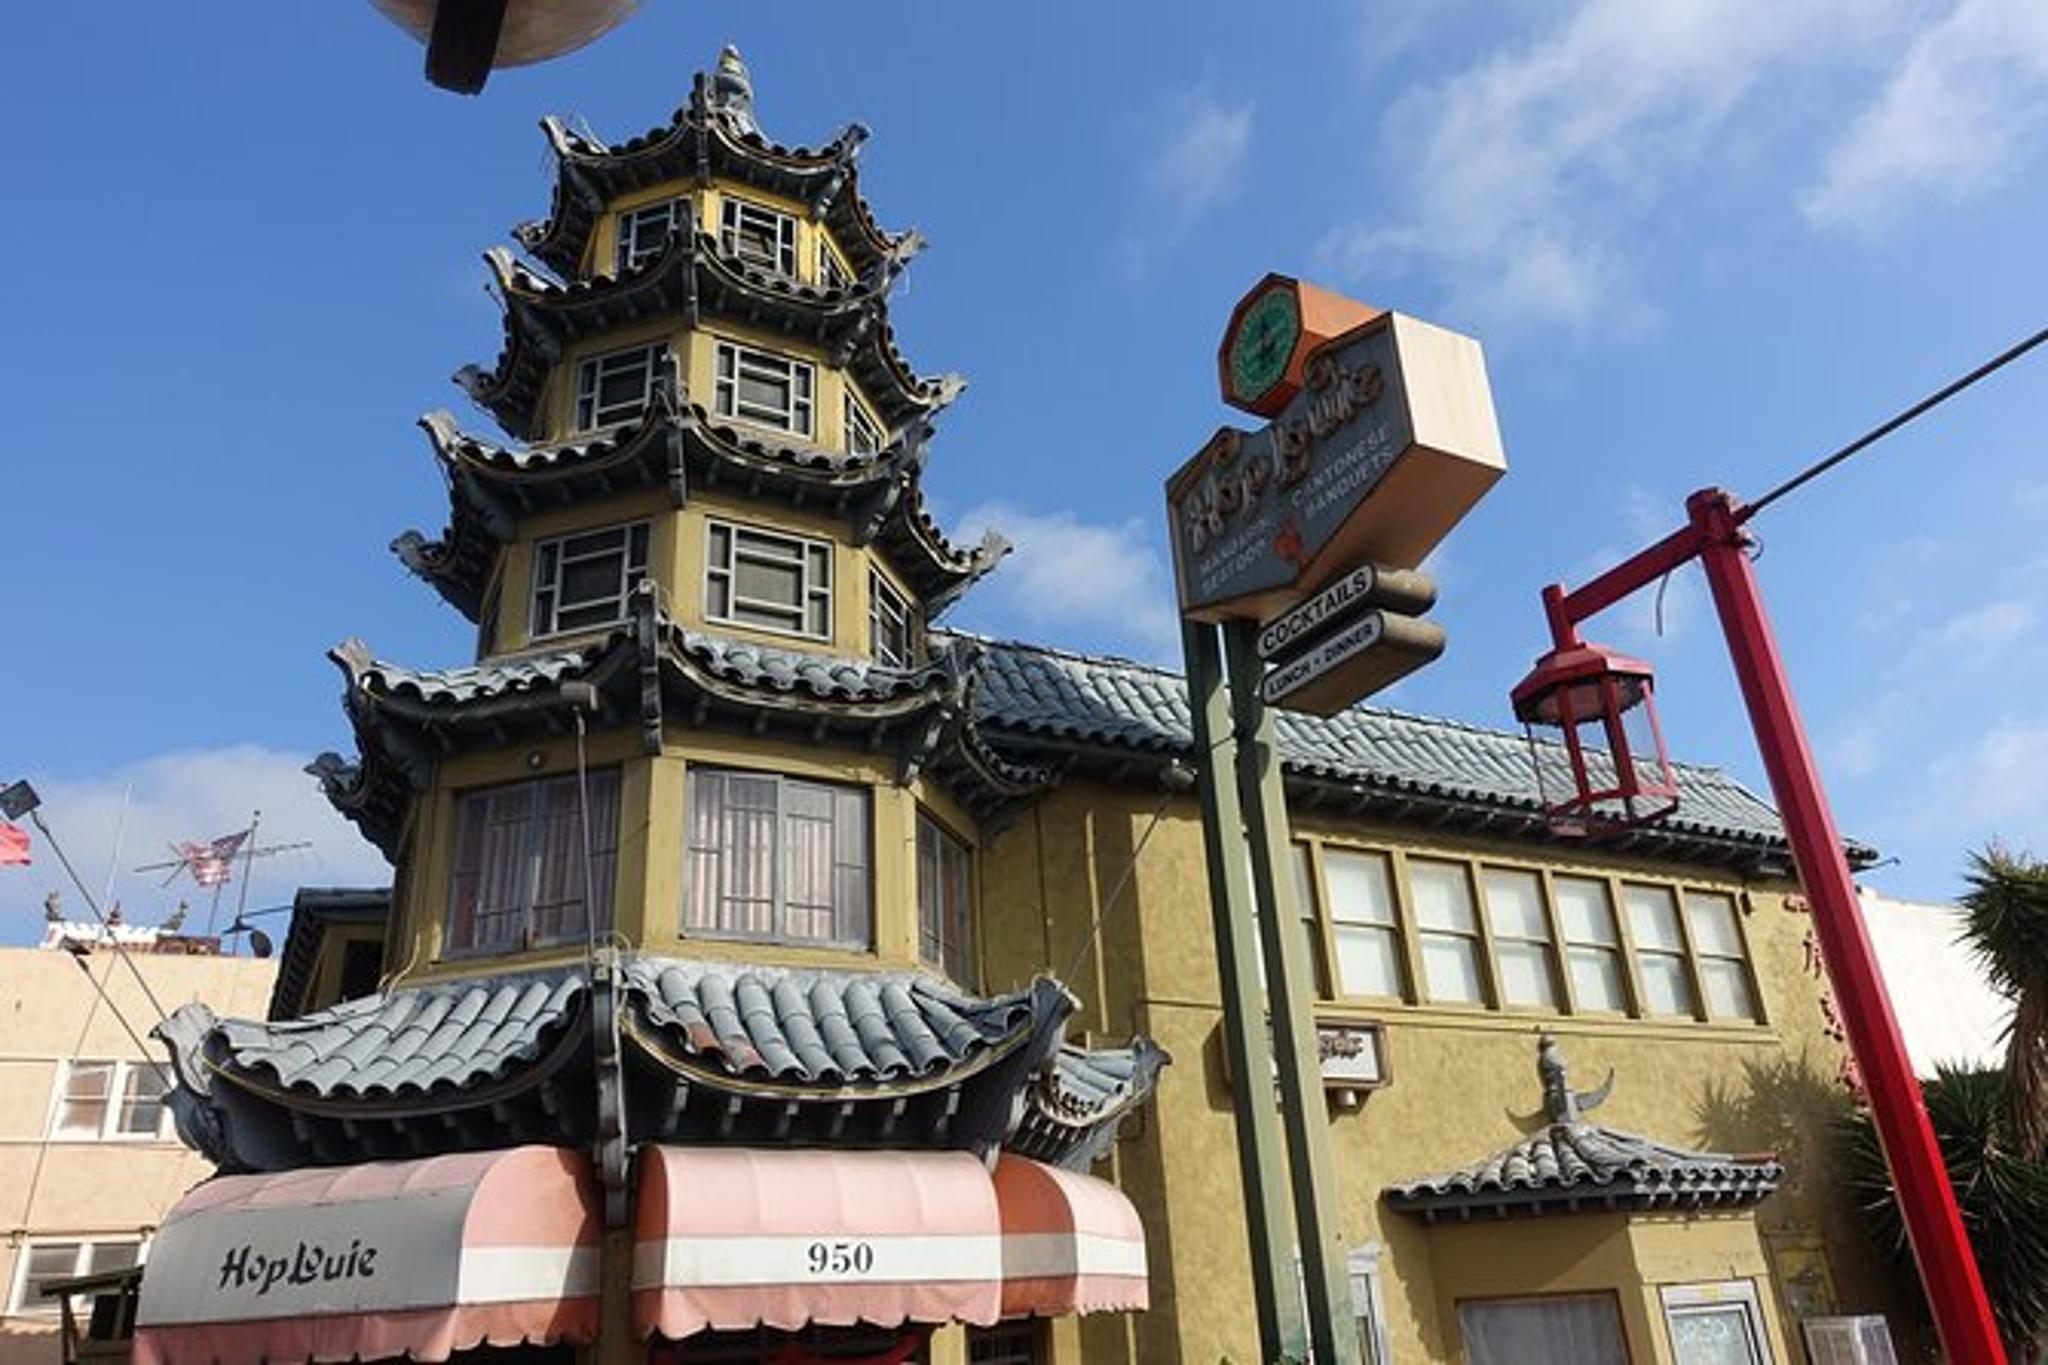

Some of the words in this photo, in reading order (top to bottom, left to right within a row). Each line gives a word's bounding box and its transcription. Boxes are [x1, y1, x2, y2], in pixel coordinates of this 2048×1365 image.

[1291, 423, 1391, 508] CANTONESE
[1263, 572, 1367, 650] COCKTAILS
[1269, 661, 1312, 695] LUNCH
[1324, 624, 1374, 661] DINNER
[808, 1242, 873, 1274] 950
